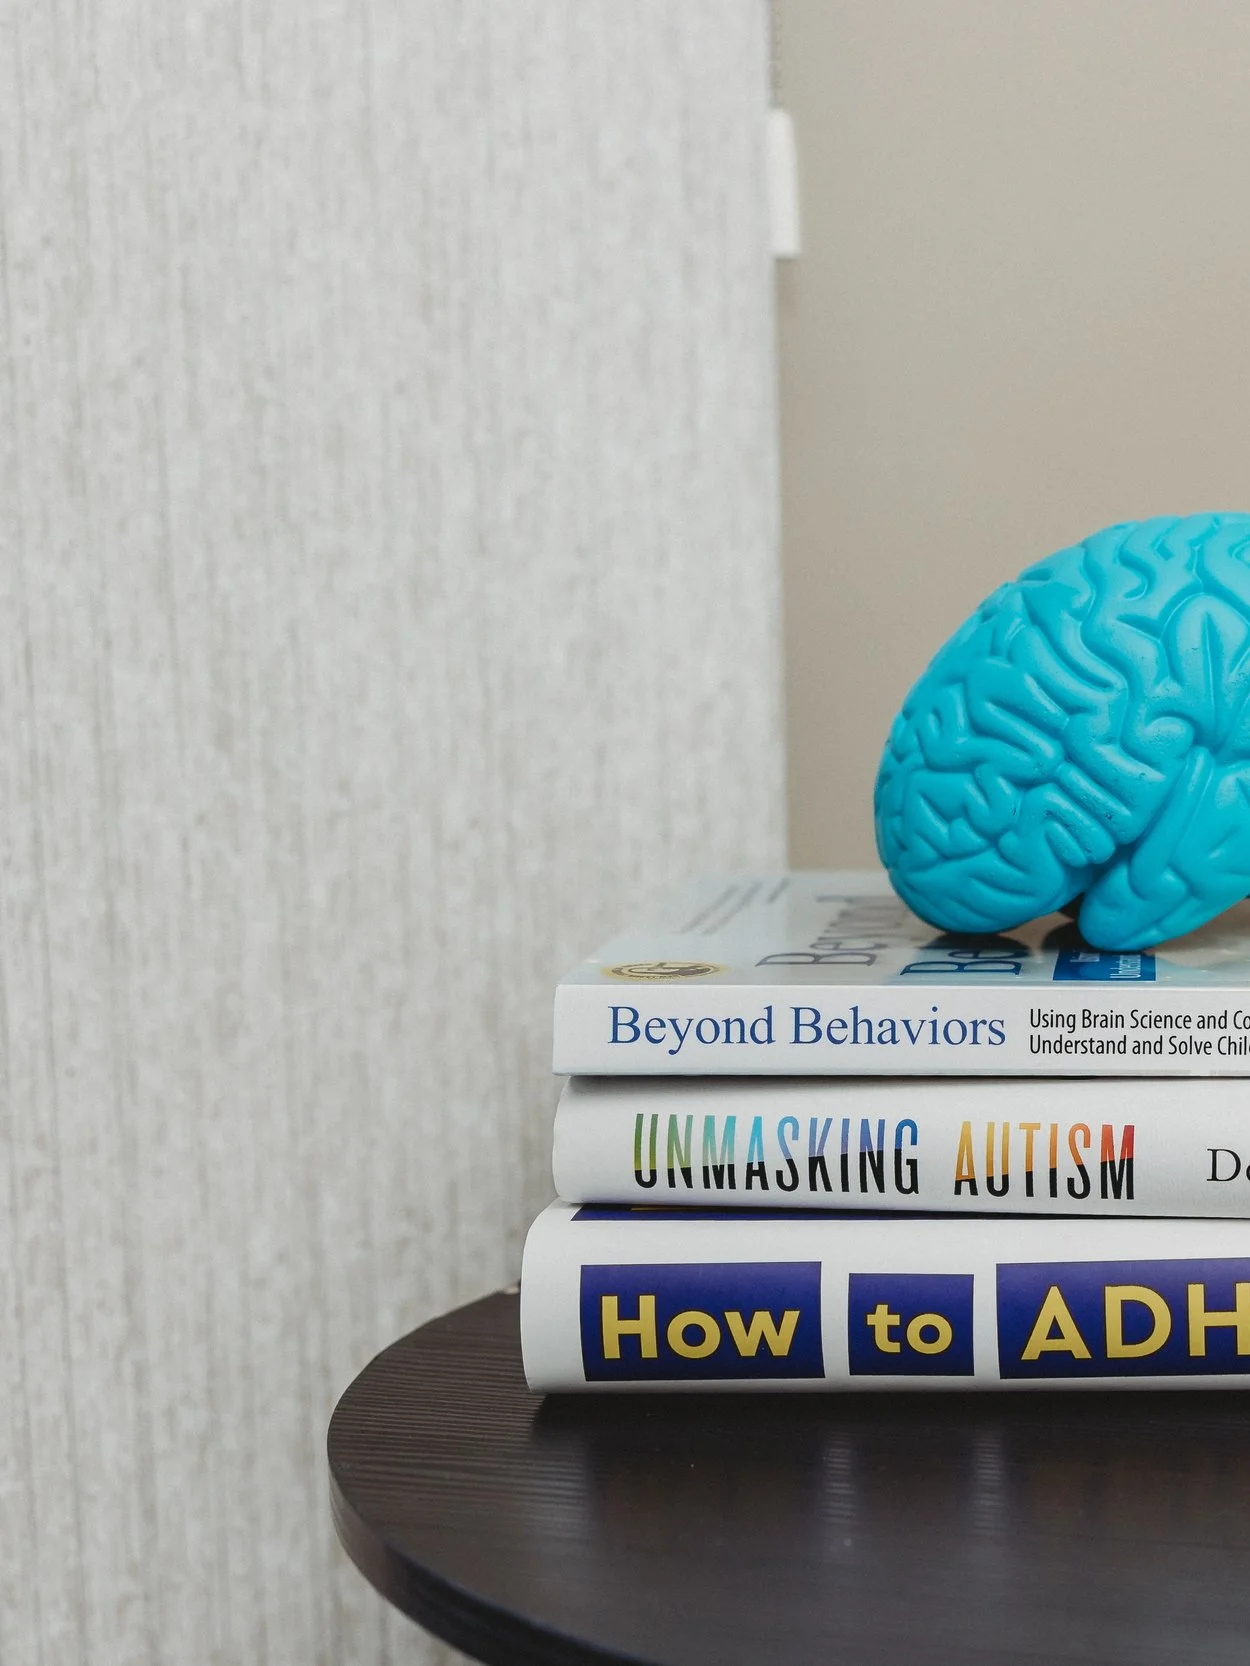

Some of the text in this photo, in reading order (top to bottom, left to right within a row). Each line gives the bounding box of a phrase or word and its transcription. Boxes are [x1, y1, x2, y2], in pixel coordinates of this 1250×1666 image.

[607, 1005, 1006, 1055] Beyond Behaviors
[1030, 1008, 1076, 1034] Using
[1081, 1008, 1125, 1029] Brain
[1130, 1009, 1192, 1029] Science
[1196, 1009, 1228, 1030] and
[1030, 1034, 1127, 1055] Understand
[1131, 1034, 1163, 1055] and
[1168, 1034, 1213, 1056] Solve
[634, 1113, 1135, 1200] UNMASKING AUTISM
[601, 1294, 801, 1360] How
[866, 1304, 953, 1355] to
